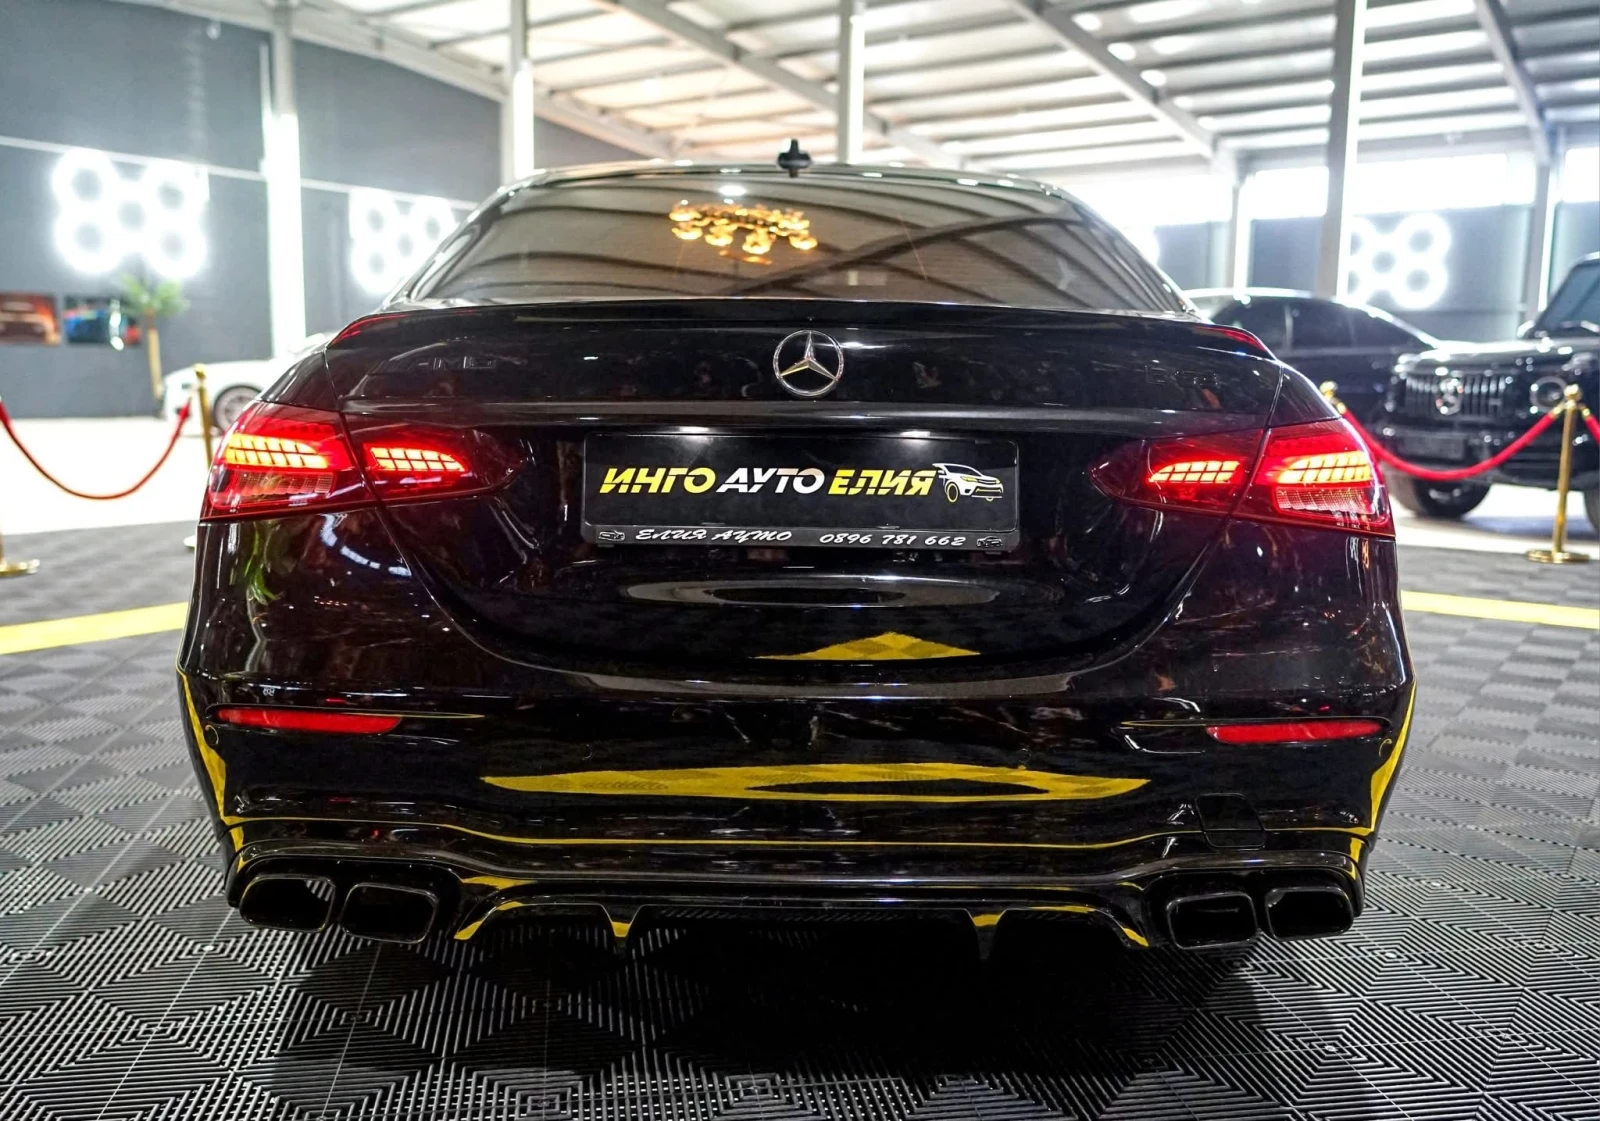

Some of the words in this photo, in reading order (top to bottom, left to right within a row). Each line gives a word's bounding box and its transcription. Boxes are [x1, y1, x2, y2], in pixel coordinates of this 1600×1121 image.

[599, 467, 716, 494] ИНГО
[715, 467, 826, 494] АУТО
[827, 469, 937, 496] ЕЛИЯ
[819, 533, 873, 544] 0896
[881, 534, 917, 545] 781
[924, 536, 966, 546] 662
